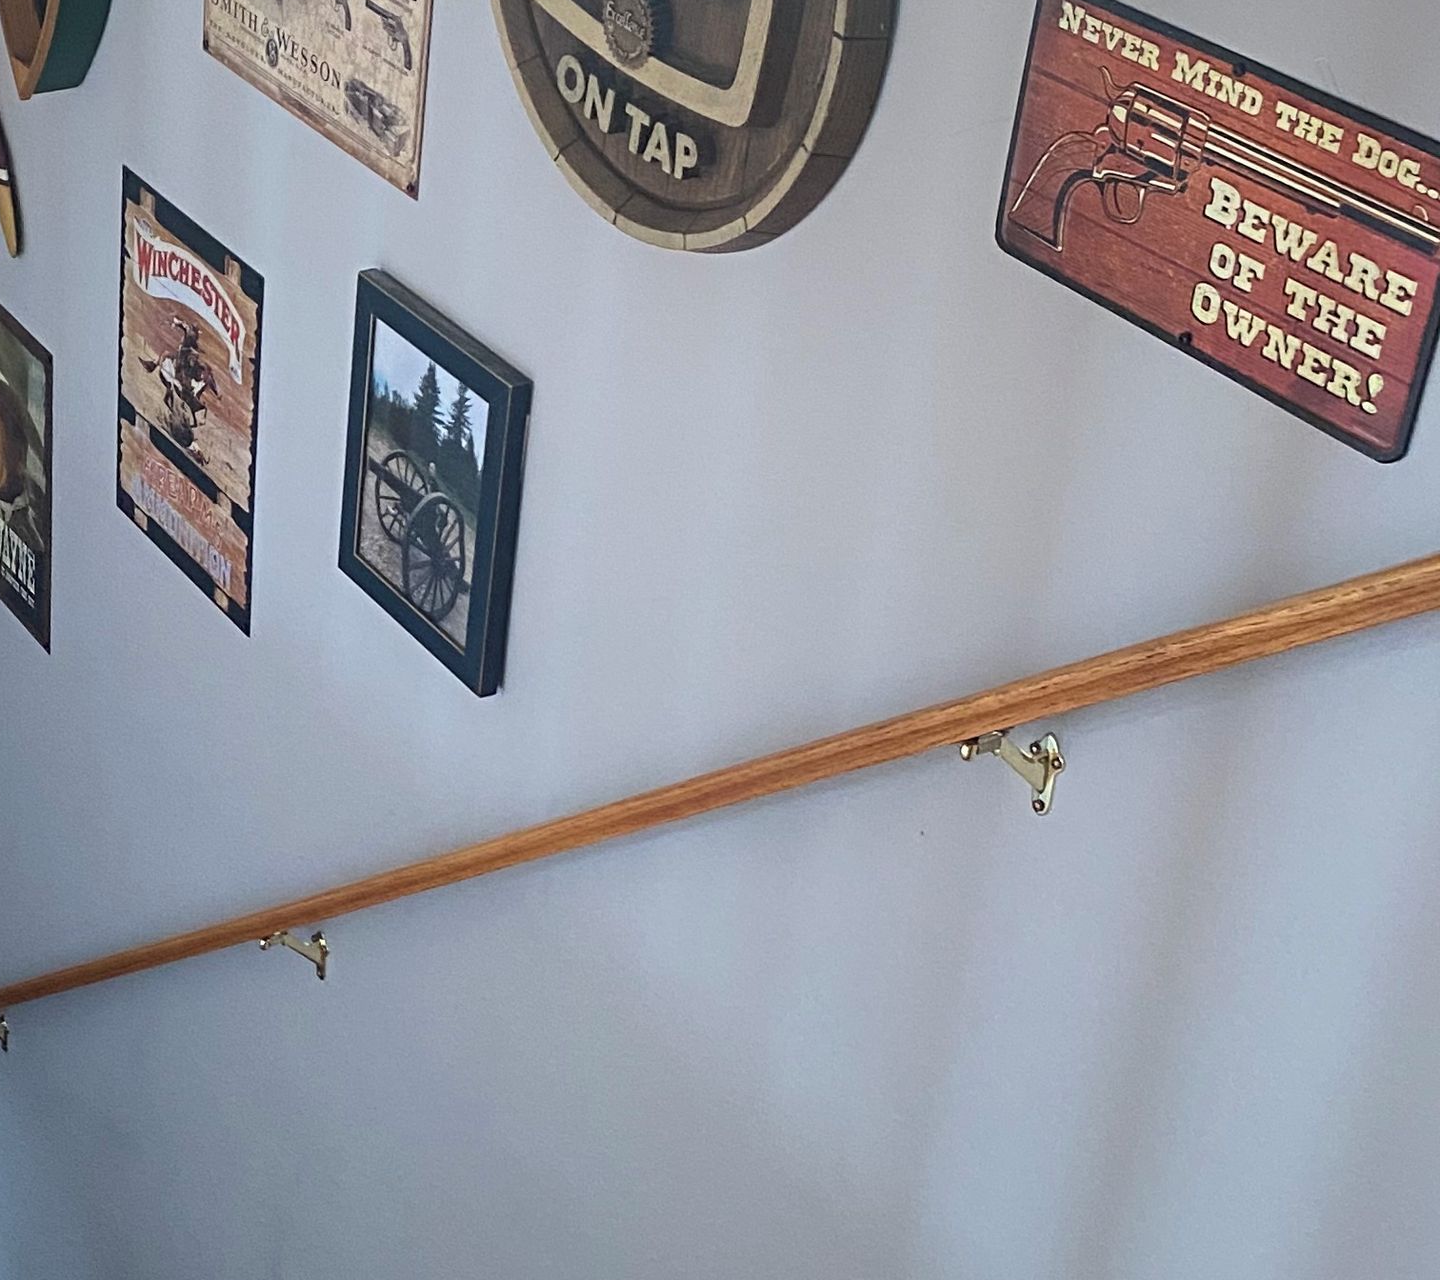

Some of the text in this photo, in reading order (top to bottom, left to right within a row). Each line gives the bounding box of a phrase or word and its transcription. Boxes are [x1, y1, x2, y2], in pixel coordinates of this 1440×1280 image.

[261, 17, 271, 38] &
[275, 24, 342, 90] WESSON
[556, 54, 698, 180] ON TAP
[1059, 0, 1440, 199] NEVER MIND THE DOG..
[135, 231, 241, 361] WINCHESTER
[1204, 177, 1418, 316] BEWARE
[1208, 243, 1387, 360] OF THE
[1190, 282, 1385, 414] OWNER!
